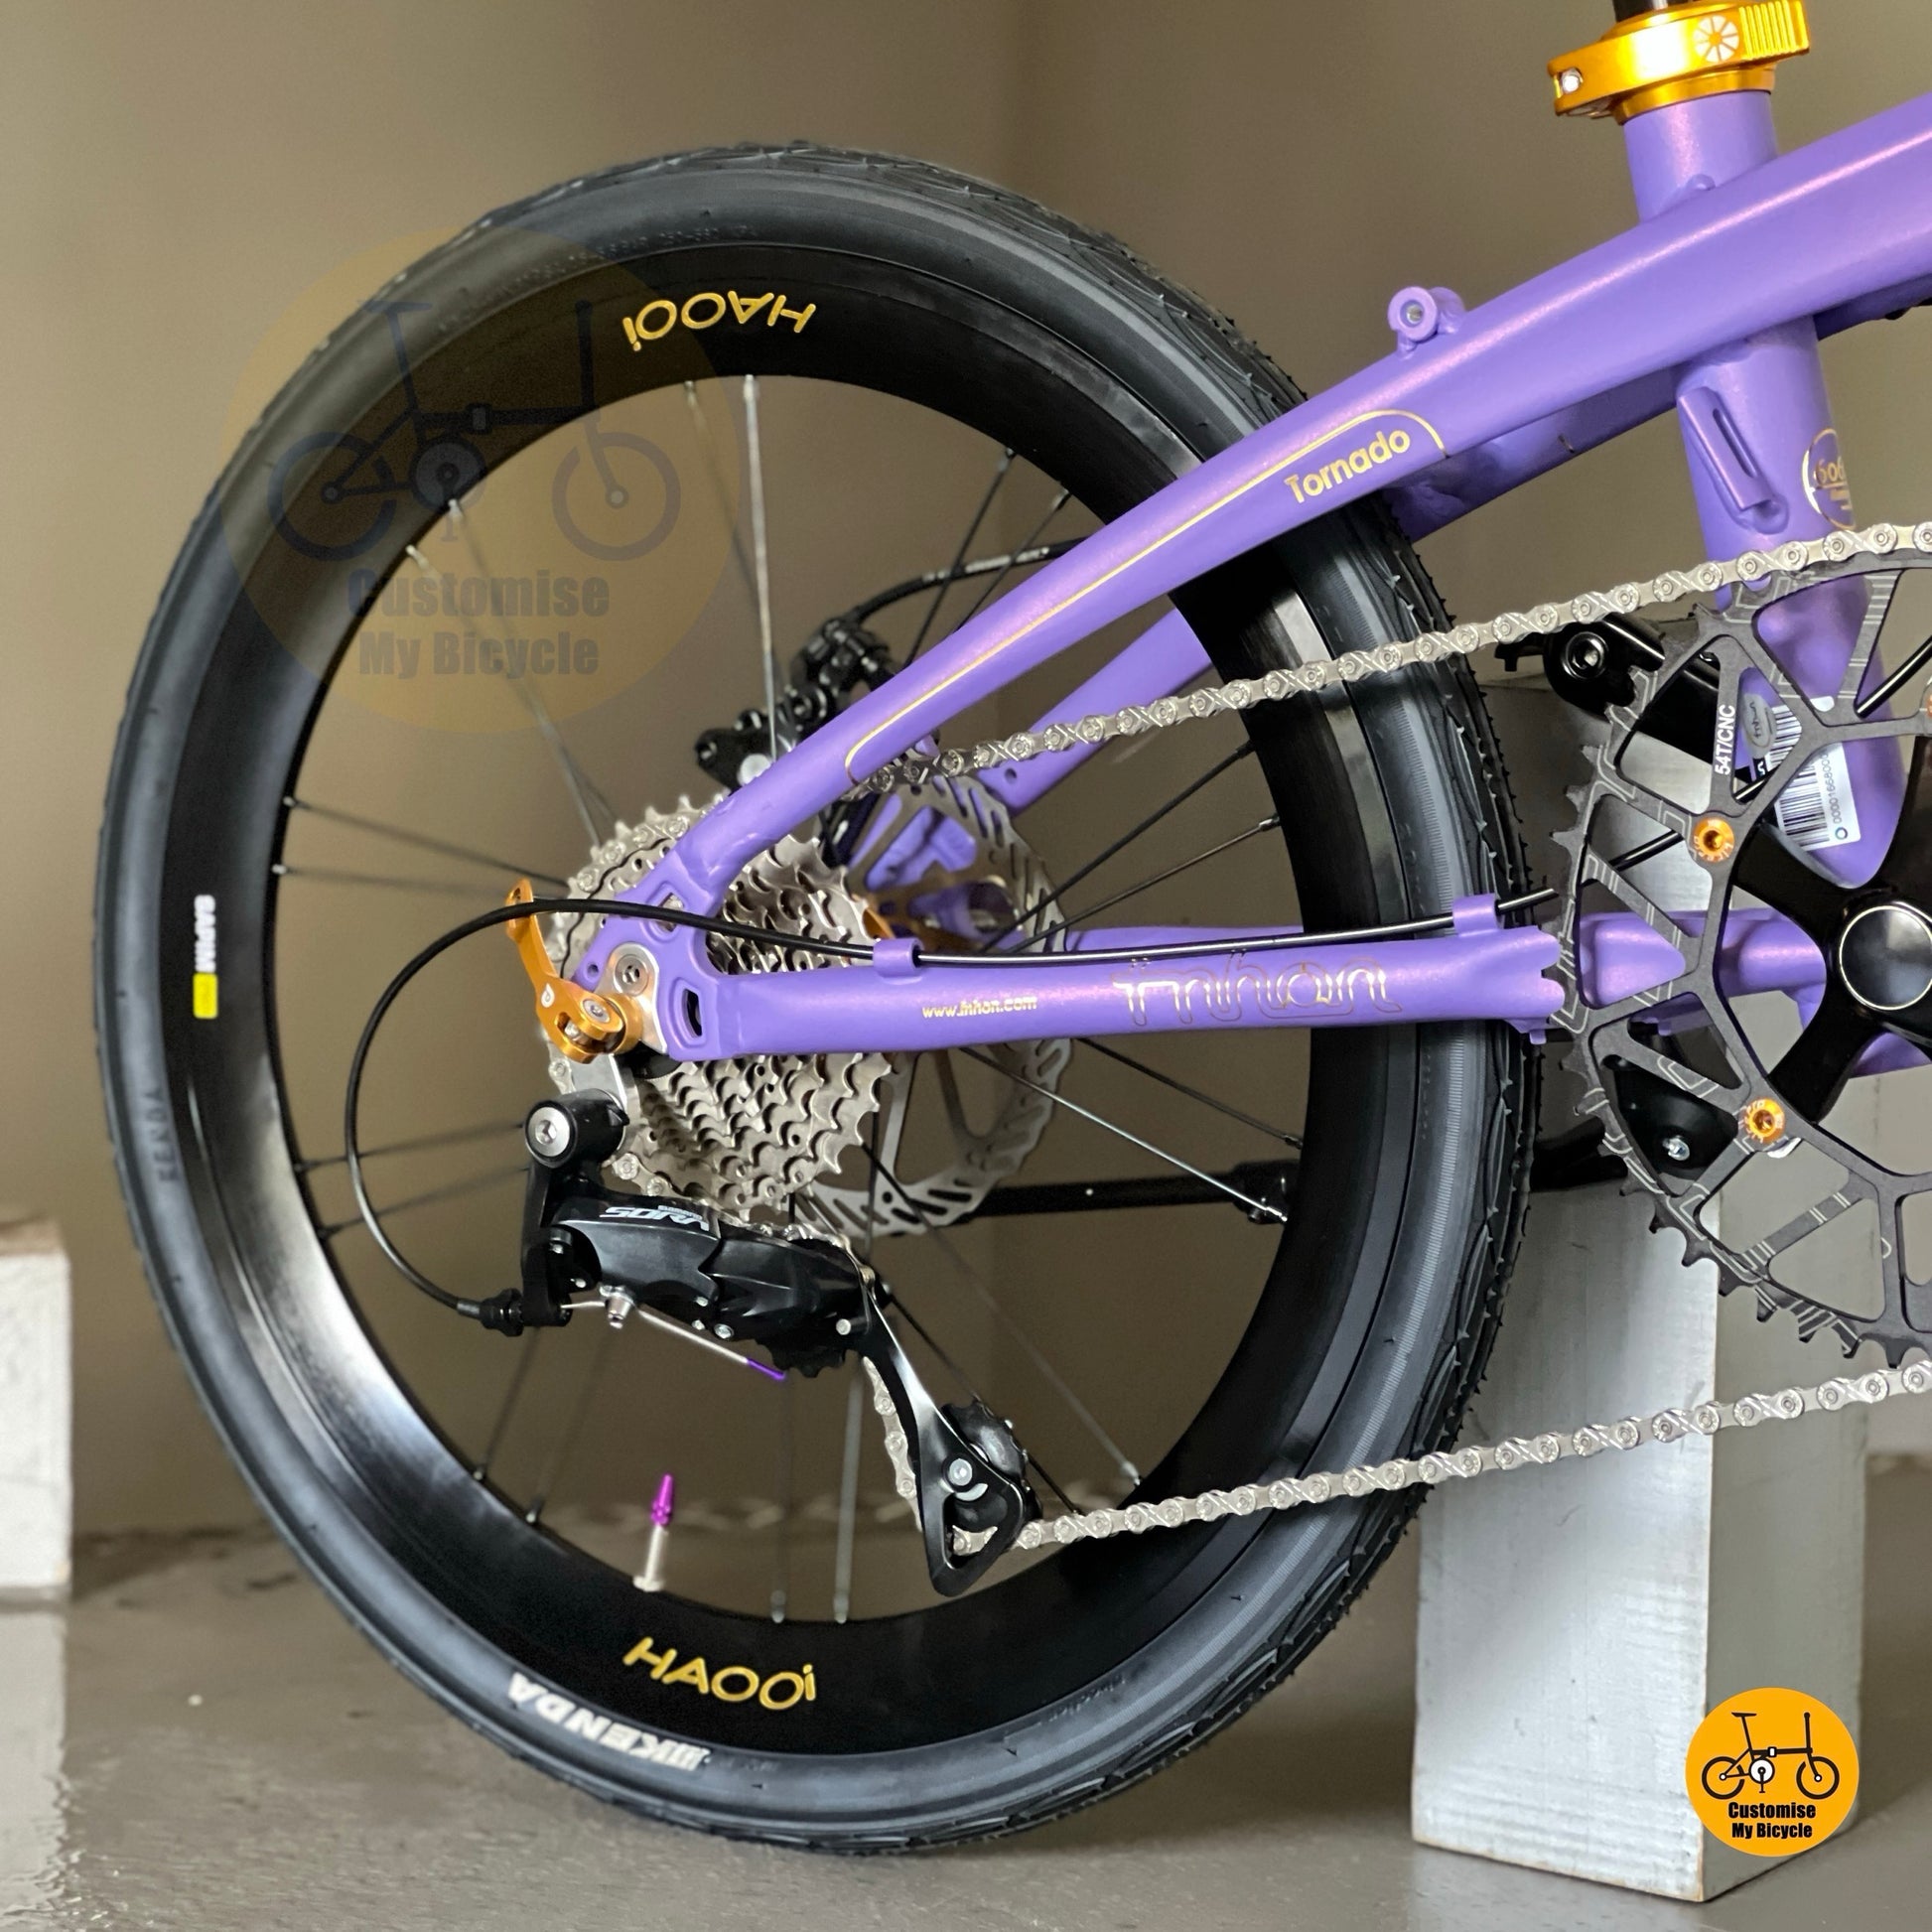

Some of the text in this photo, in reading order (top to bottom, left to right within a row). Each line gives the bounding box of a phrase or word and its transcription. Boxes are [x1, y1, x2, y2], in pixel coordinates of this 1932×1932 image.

[1284, 430, 1411, 503] Tornado
[1715, 704, 1735, 775] 54T/CNC
[599, 1206, 710, 1232] SORA
[507, 1671, 677, 1766] KENDA
